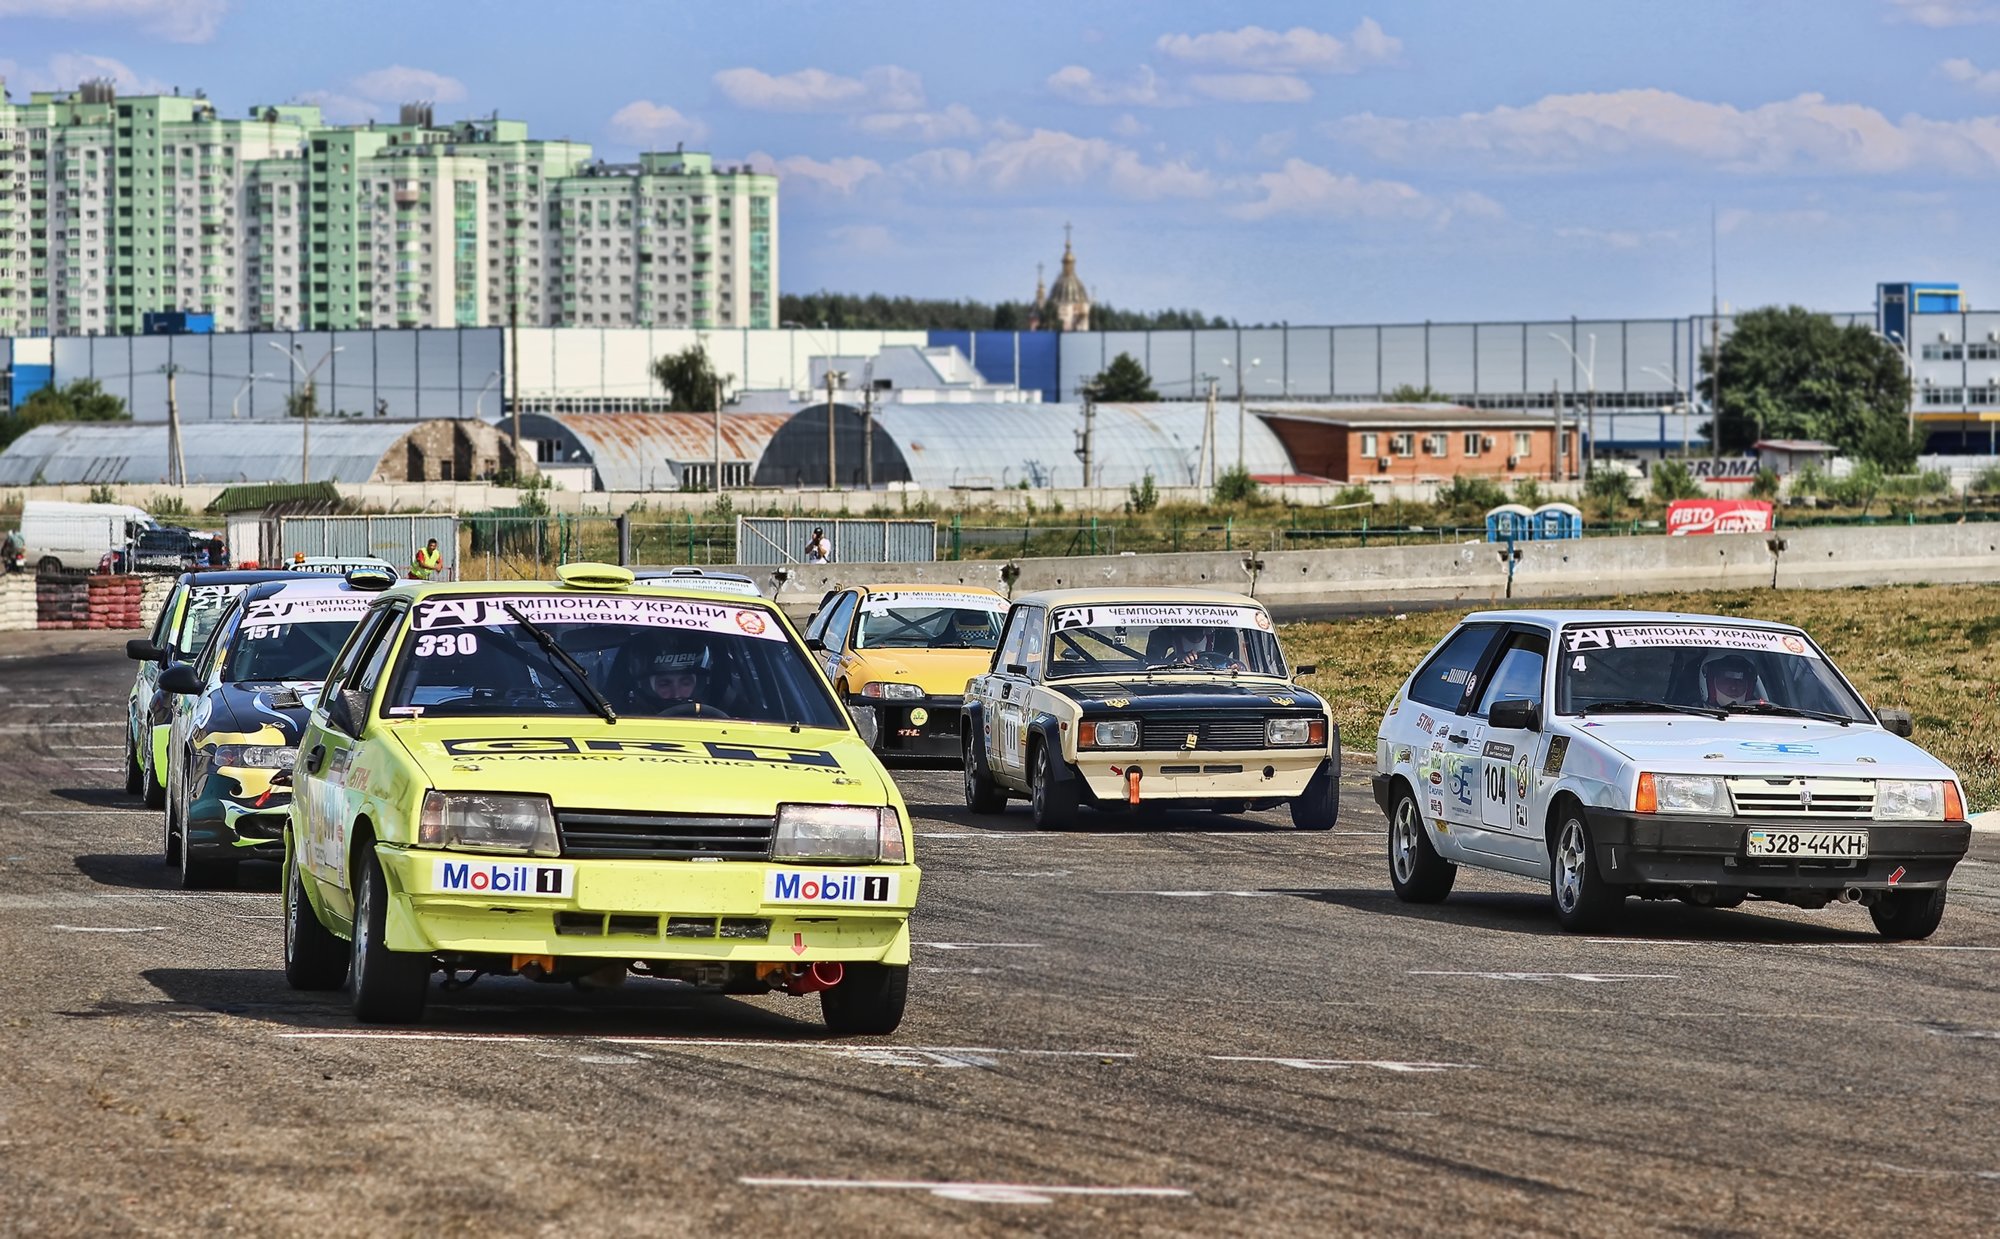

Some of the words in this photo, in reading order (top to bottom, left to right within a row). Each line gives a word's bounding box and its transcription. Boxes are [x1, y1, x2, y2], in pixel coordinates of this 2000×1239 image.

[1671, 508, 1714, 526] АВТО
[486, 599, 624, 609] ЧЕМПІОНАТ
[631, 601, 727, 619] УКРАЇНИ
[1109, 607, 1182, 616] ЧЕМПІОНАТ
[1186, 607, 1239, 617] УКРАЇНИ
[244, 625, 281, 640] 151
[1613, 628, 1706, 637] ЧЕМПІОНАТ
[1711, 629, 1778, 642] УКРАЇНИ
[415, 633, 477, 657] 330
[654, 653, 697, 667] NOLAN
[1572, 655, 1587, 672] 4
[638, 757, 755, 767] RACING
[762, 763, 847, 775] TEAM
[1485, 763, 1506, 805] 104
[443, 862, 527, 891] Mobil
[541, 869, 556, 892] 1
[775, 873, 856, 900] Mobil
[869, 877, 884, 900] 1
